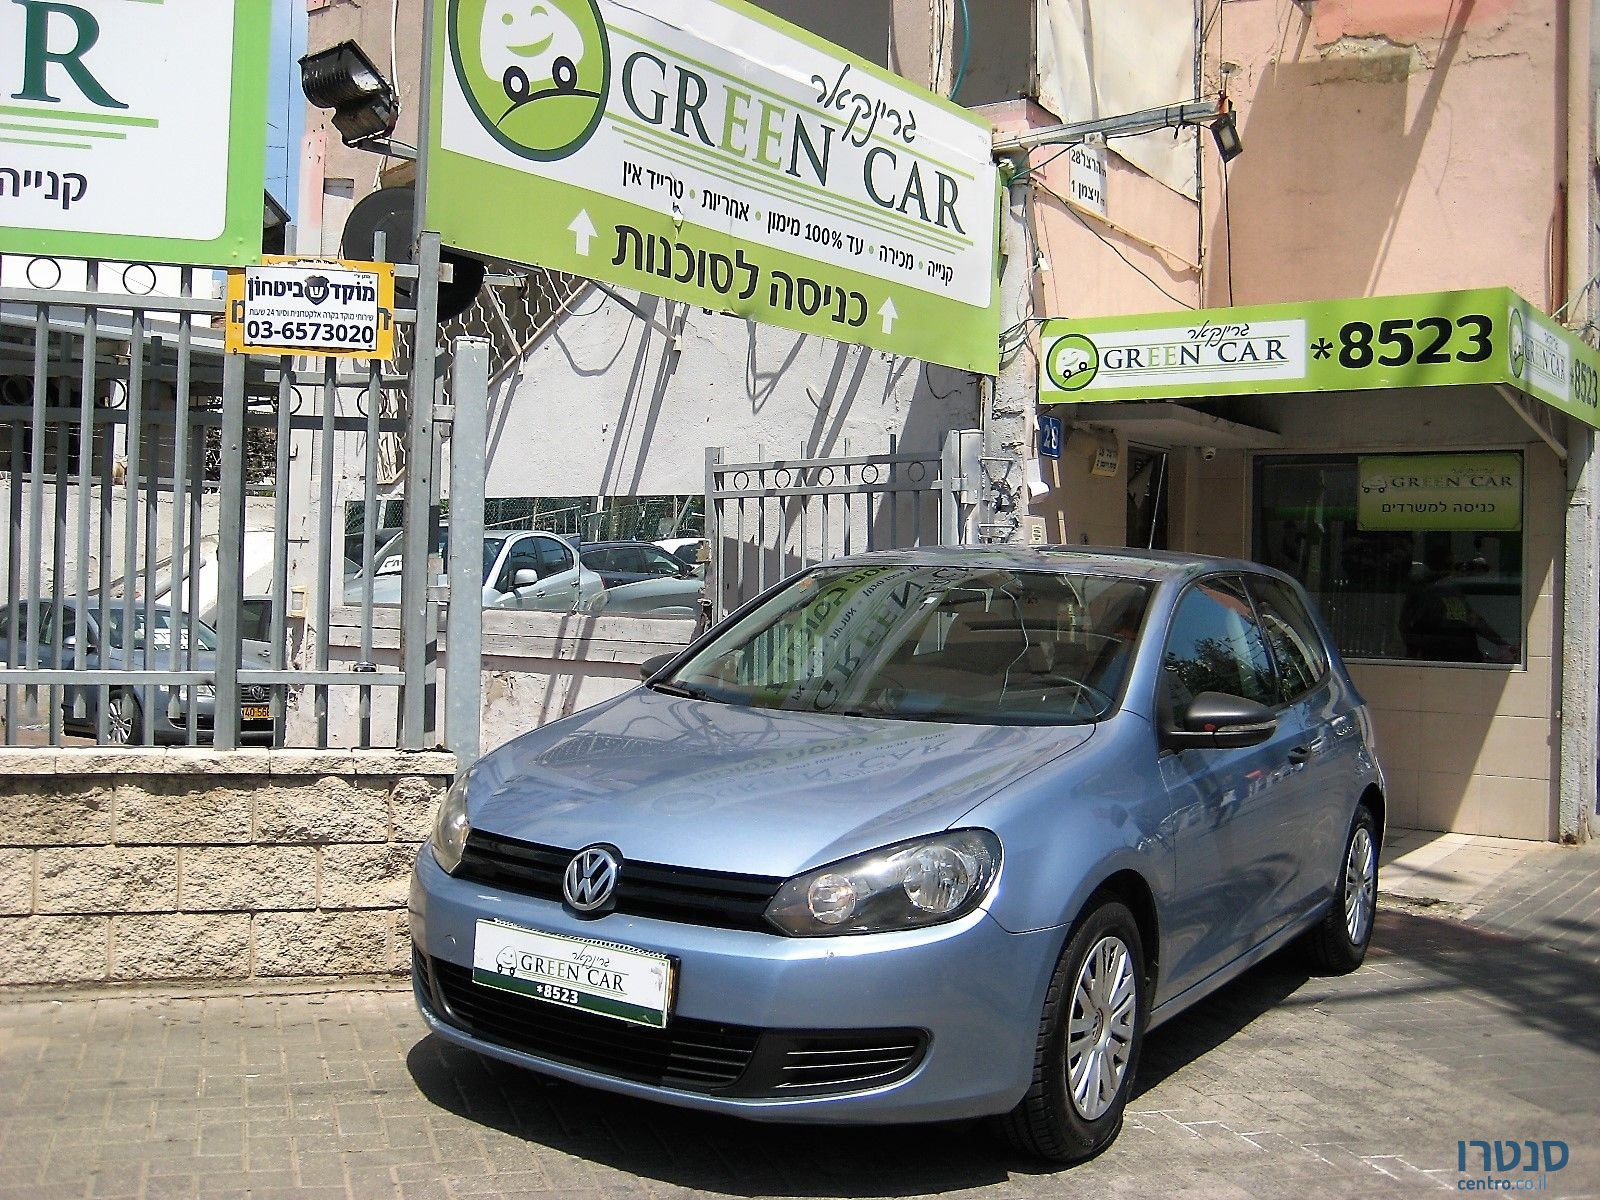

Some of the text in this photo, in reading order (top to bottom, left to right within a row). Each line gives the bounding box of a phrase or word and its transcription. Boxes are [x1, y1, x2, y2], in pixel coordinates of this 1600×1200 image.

[811, 64, 916, 147] גרינקאר
[621, 51, 966, 235] GREEN CAR
[623, 160, 953, 286] קנייה מכירה עד 100% מימון אחריות טרייד אין
[611, 225, 868, 327] כניסה לסוכנות
[248, 277, 305, 301] ביטחון
[330, 282, 375, 305] מוקד
[266, 308, 274, 316] 24
[322, 311, 339, 320] בקרה
[247, 320, 374, 344] 03-6573020
[1103, 339, 1288, 370] GREEN CAR
[1043, 424, 1059, 450] 28
[1471, 476, 1513, 488] CAR
[1382, 501, 1495, 513] כניסה למשרדים
[520, 954, 624, 992] GREEN CAR
